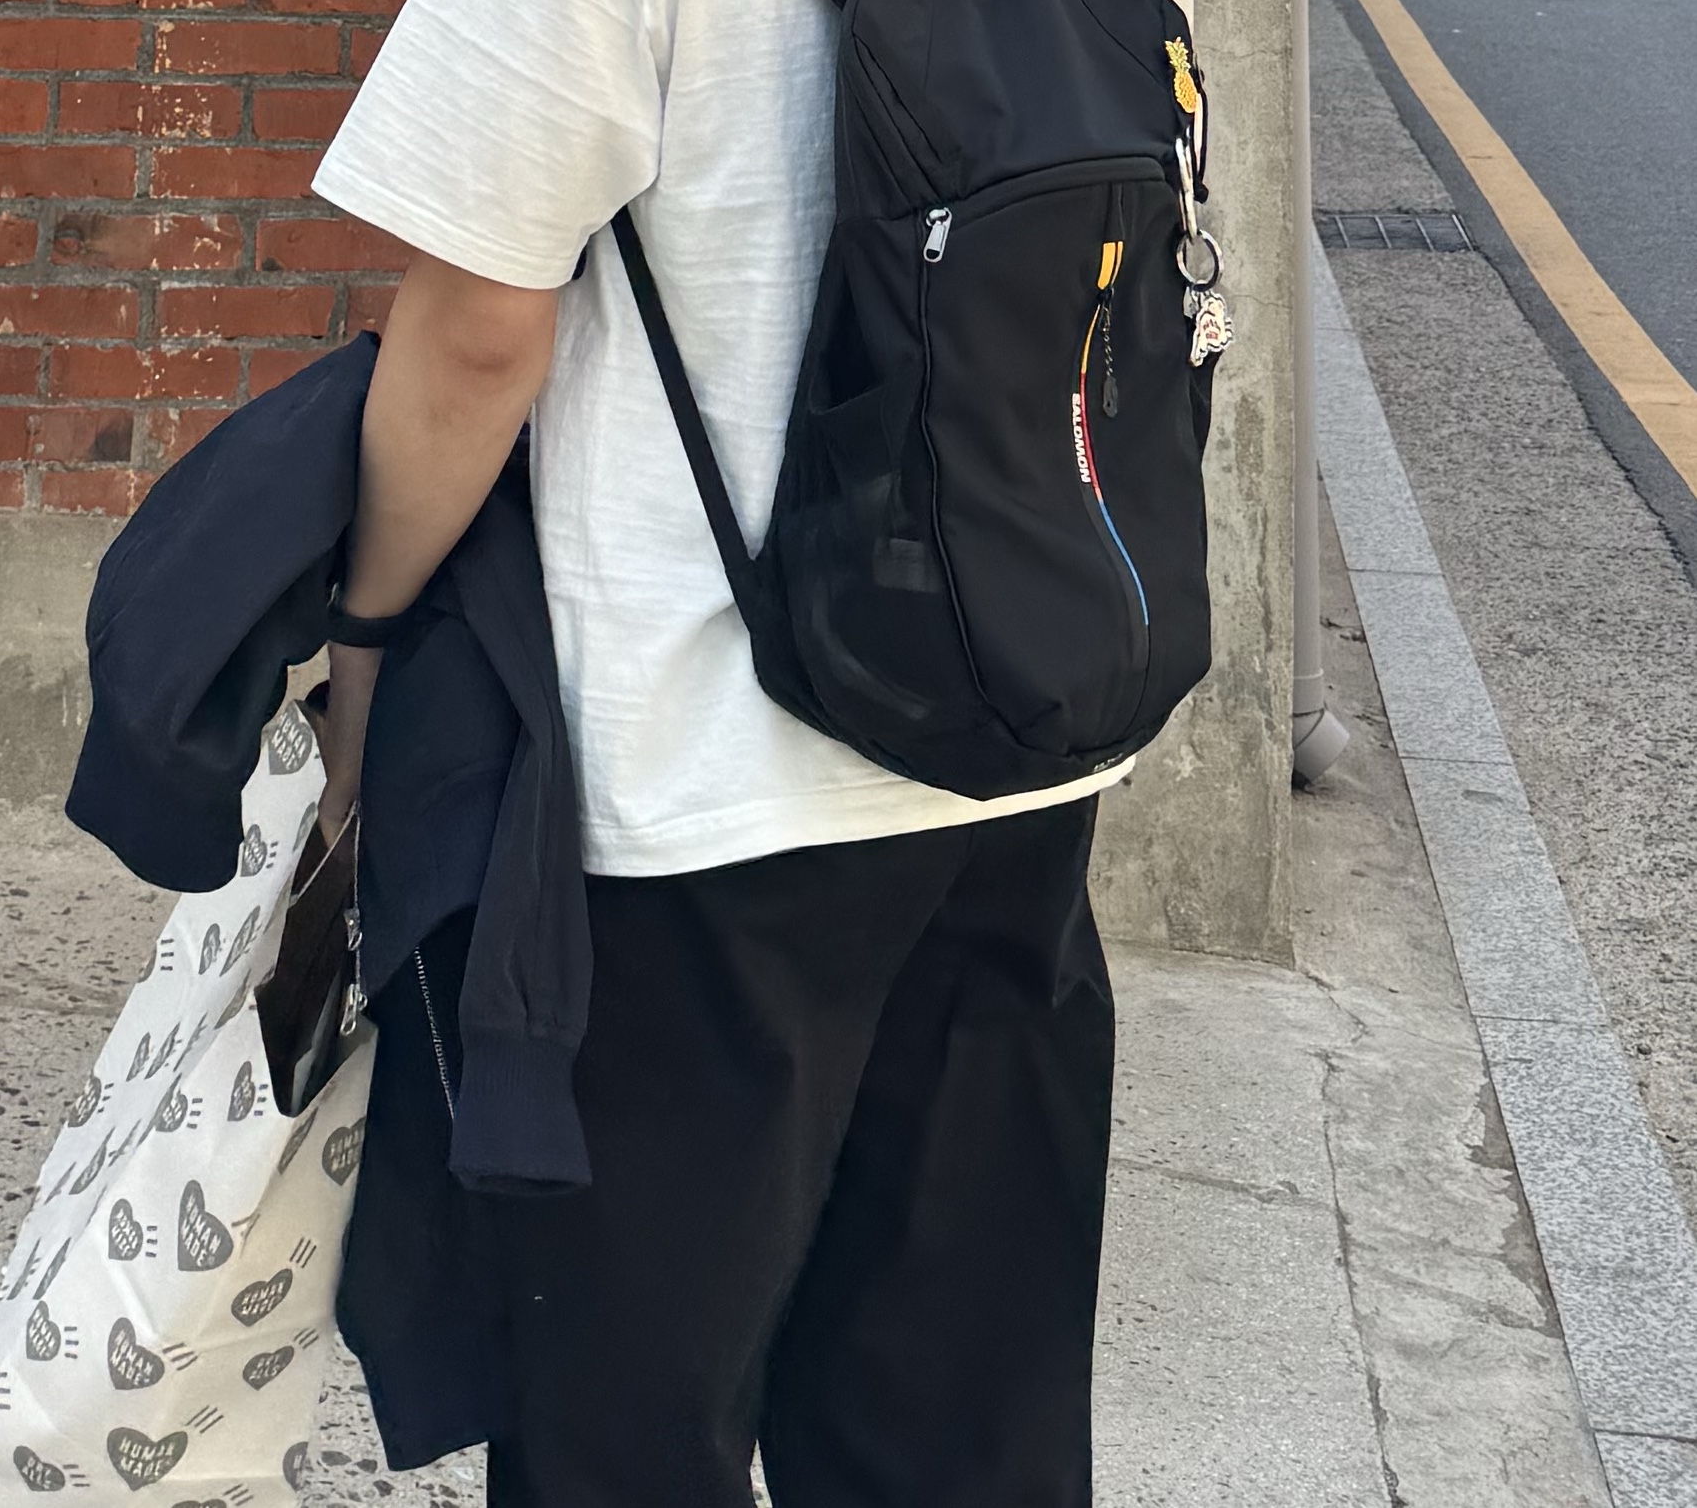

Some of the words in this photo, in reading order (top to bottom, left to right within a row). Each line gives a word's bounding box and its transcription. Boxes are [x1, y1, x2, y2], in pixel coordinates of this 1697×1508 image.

[1071, 393, 1092, 484] SALOMON
[181, 1218, 208, 1268] MADE
[186, 1193, 222, 1254] HUMAN
[109, 1346, 143, 1386] MADE
[114, 1329, 153, 1376] HUMAN
[119, 1435, 176, 1462] HUMAN
[120, 1457, 161, 1477] MADE
